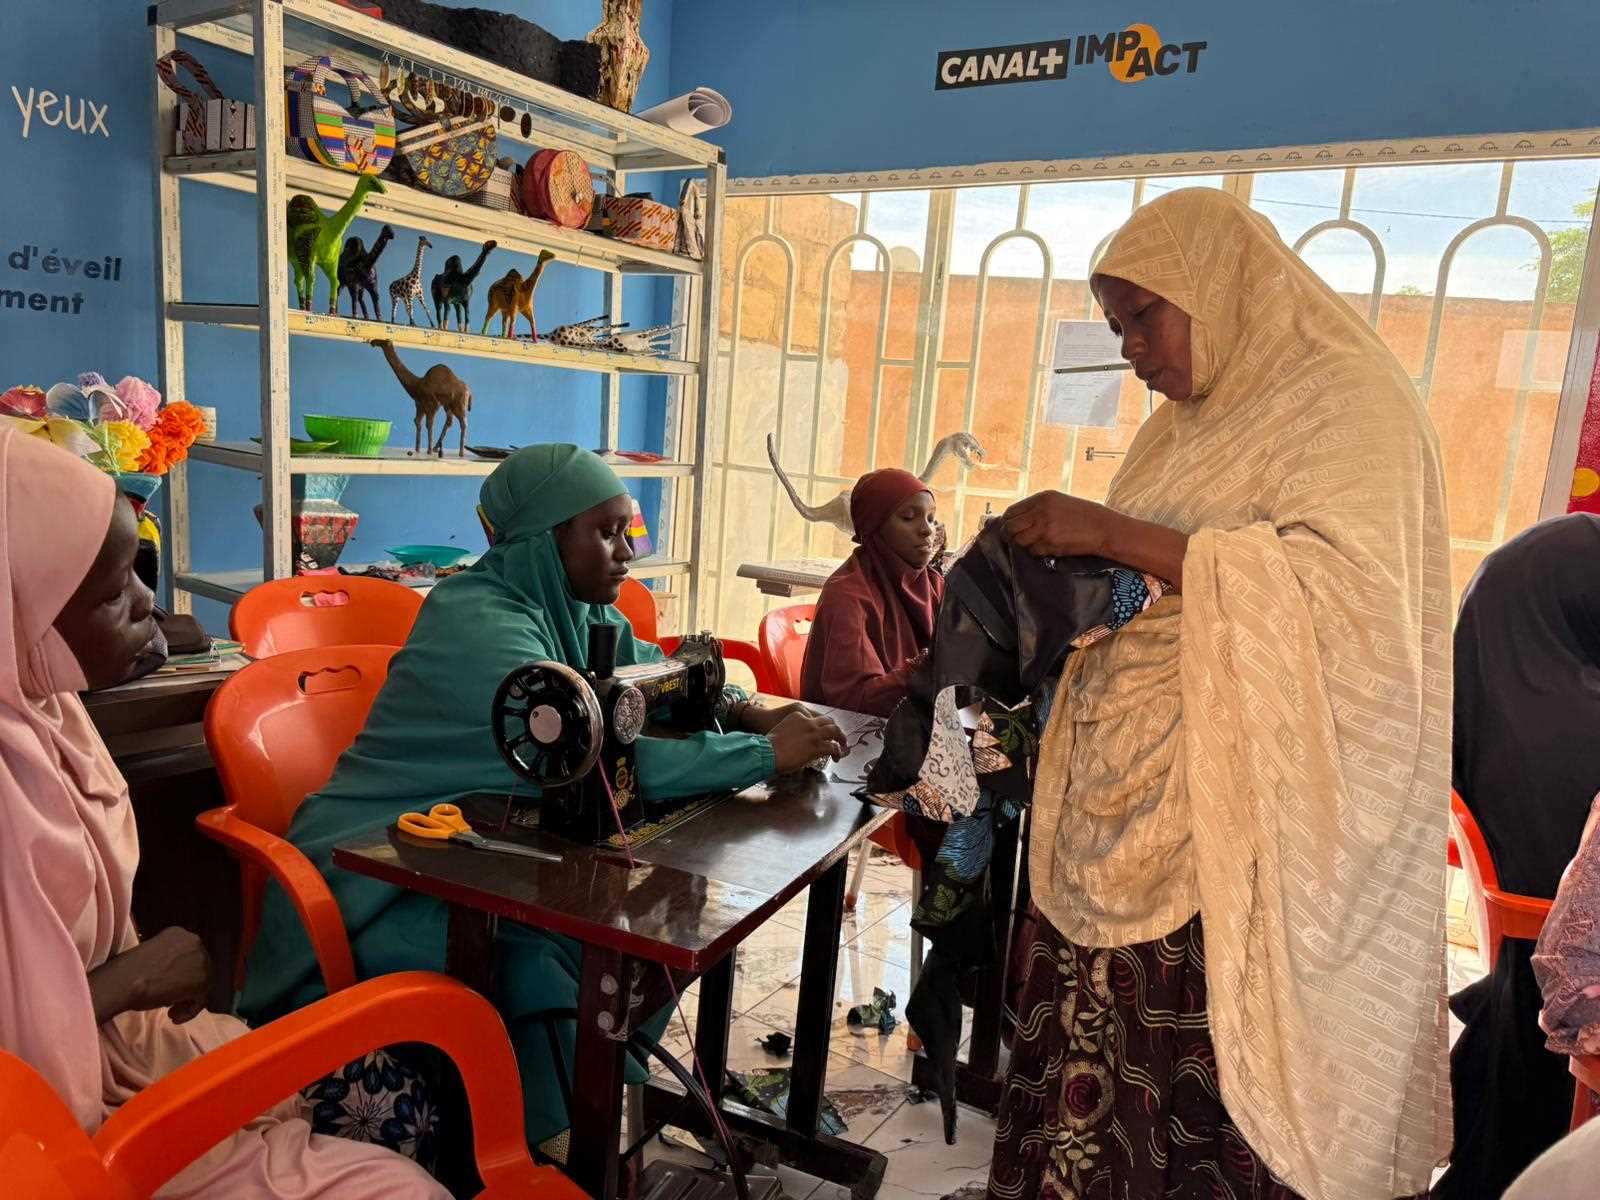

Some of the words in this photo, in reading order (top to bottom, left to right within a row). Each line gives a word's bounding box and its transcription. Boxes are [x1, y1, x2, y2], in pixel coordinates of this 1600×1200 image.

[940, 47, 1064, 85] CANAL+
[1074, 31, 1207, 78] IMPACT
[11, 85, 109, 138] yeux
[8, 245, 122, 282] d'éveil
